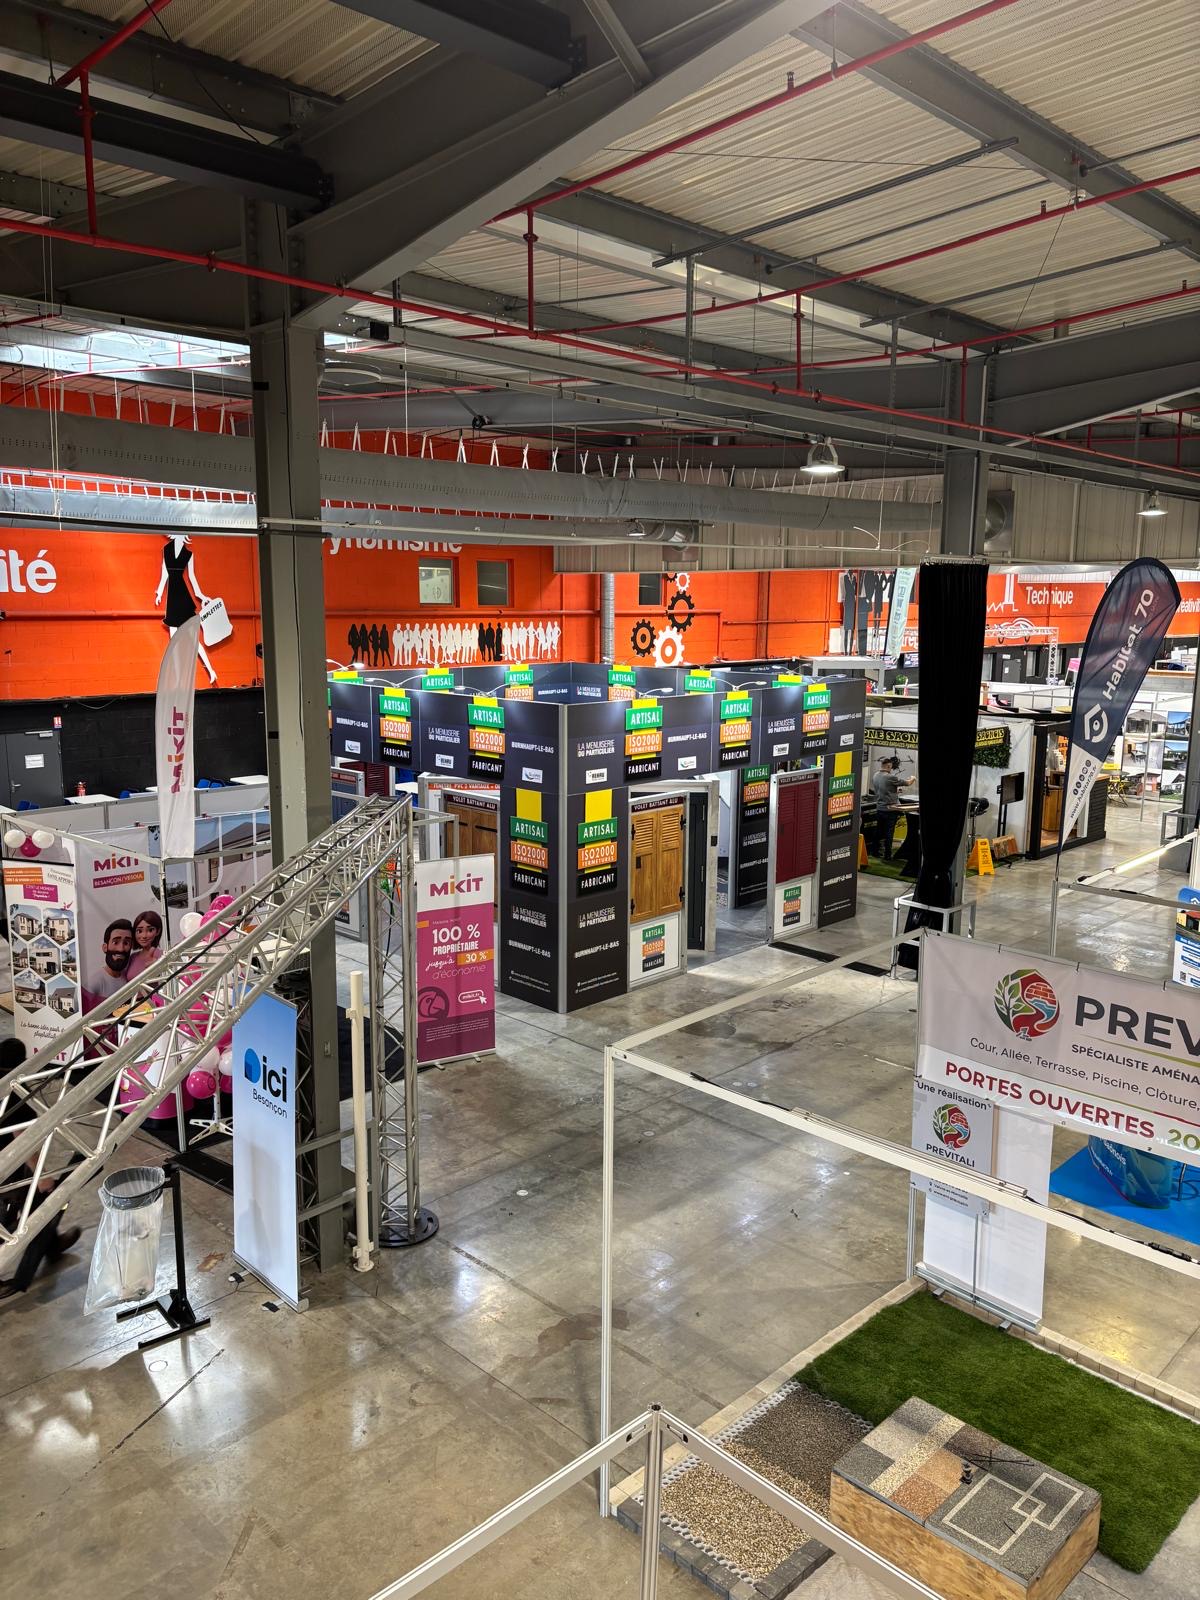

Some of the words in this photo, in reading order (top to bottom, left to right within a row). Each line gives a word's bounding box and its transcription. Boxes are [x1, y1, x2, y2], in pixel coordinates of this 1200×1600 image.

[322, 536, 462, 555] ynamisme
[1026, 586, 1074, 606] Technique
[199, 601, 222, 622] EMPLETTES
[1102, 623, 1142, 700] Habitat
[1134, 589, 1154, 619] 70
[426, 678, 452, 687] ARTISAL
[509, 673, 531, 682] ARTISAL
[612, 673, 634, 683] ARTISAL
[688, 679, 713, 689] ARTISAL
[383, 699, 409, 713] ARTISAL
[806, 694, 829, 706] ARTISAL
[724, 702, 750, 715] ARTISAL
[473, 710, 502, 724] ARTISAL
[630, 711, 660, 726] ARTISAL
[805, 713, 829, 726] ISO2000
[383, 720, 410, 732] ISO2000
[428, 727, 435, 735] LA
[435, 728, 460, 738] MENUISERIE
[722, 723, 750, 737] ISO2000
[435, 735, 460, 744] PARTICULIER
[472, 731, 503, 746] ISO2000
[577, 743, 585, 751] LA
[585, 739, 615, 750] MENUISERIE
[629, 734, 660, 747] ISO2000
[803, 738, 827, 749] FABRICANT
[383, 747, 411, 759] FABRICANT
[511, 741, 555, 754] BURNHAUPT-LE-BAS
[586, 746, 615, 756] PARTICULIER
[722, 749, 749, 761] FABRICANT
[472, 760, 503, 773] FABRICANT
[628, 762, 660, 775] FABRICANT
[747, 767, 769, 778] ARTISAL
[746, 784, 769, 795] ISO2000
[832, 778, 853, 790] ARTISAL
[452, 795, 466, 803] VOLET
[466, 798, 485, 807] BATTANT
[634, 801, 648, 811] VOLET
[649, 799, 668, 809] BATTANT
[830, 795, 853, 809] ISO2000
[744, 807, 767, 817] FABRICANT
[515, 822, 545, 839] ARTISAL
[583, 822, 615, 838] ARTISAL
[829, 819, 852, 831] FABRICANT
[514, 845, 546, 861] ISO2000
[581, 845, 615, 861] ISO2000
[514, 855, 545, 867] FERMETURES
[581, 856, 614, 867] FERMETURES
[514, 872, 546, 889] FABRICANT
[581, 873, 615, 889] FABRICANT
[512, 906, 519, 914] LA
[519, 907, 547, 921] MENUISERIE
[579, 914, 586, 923] LA
[587, 906, 616, 920] MENUISERIE
[519, 915, 547, 928] PARTICULIER
[579, 921, 586, 929] DU
[587, 914, 616, 926] PARTICULIER
[432, 925, 462, 944] 100
[467, 923, 481, 939] %
[645, 928, 663, 938] ARTISAL
[433, 940, 479, 956] PROPRIÉTAIRE
[508, 939, 551, 958] BURNHAUPT-LE-BAS
[574, 940, 620, 959] BURNHAUPT-LE-BAS
[465, 952, 477, 963] 30
[644, 957, 663, 968] FABRICANT
[431, 964, 487, 981] d'économie
[1075, 995, 1200, 1056] PREV
[1072, 1042, 1149, 1072] SPÉCIALISTE
[970, 1037, 998, 1055] Cour,
[1001, 1047, 1032, 1065] Allée,
[1036, 1055, 1088, 1081] Terrasse,
[1092, 1071, 1142, 1096] Piscine,
[262, 1055, 287, 1102] ici
[252, 1089, 288, 1119] Besançon
[945, 1060, 1023, 1100] PORTES
[1029, 1088, 1155, 1139] OUVERTES
[926, 1142, 975, 1168] PREVITALI
